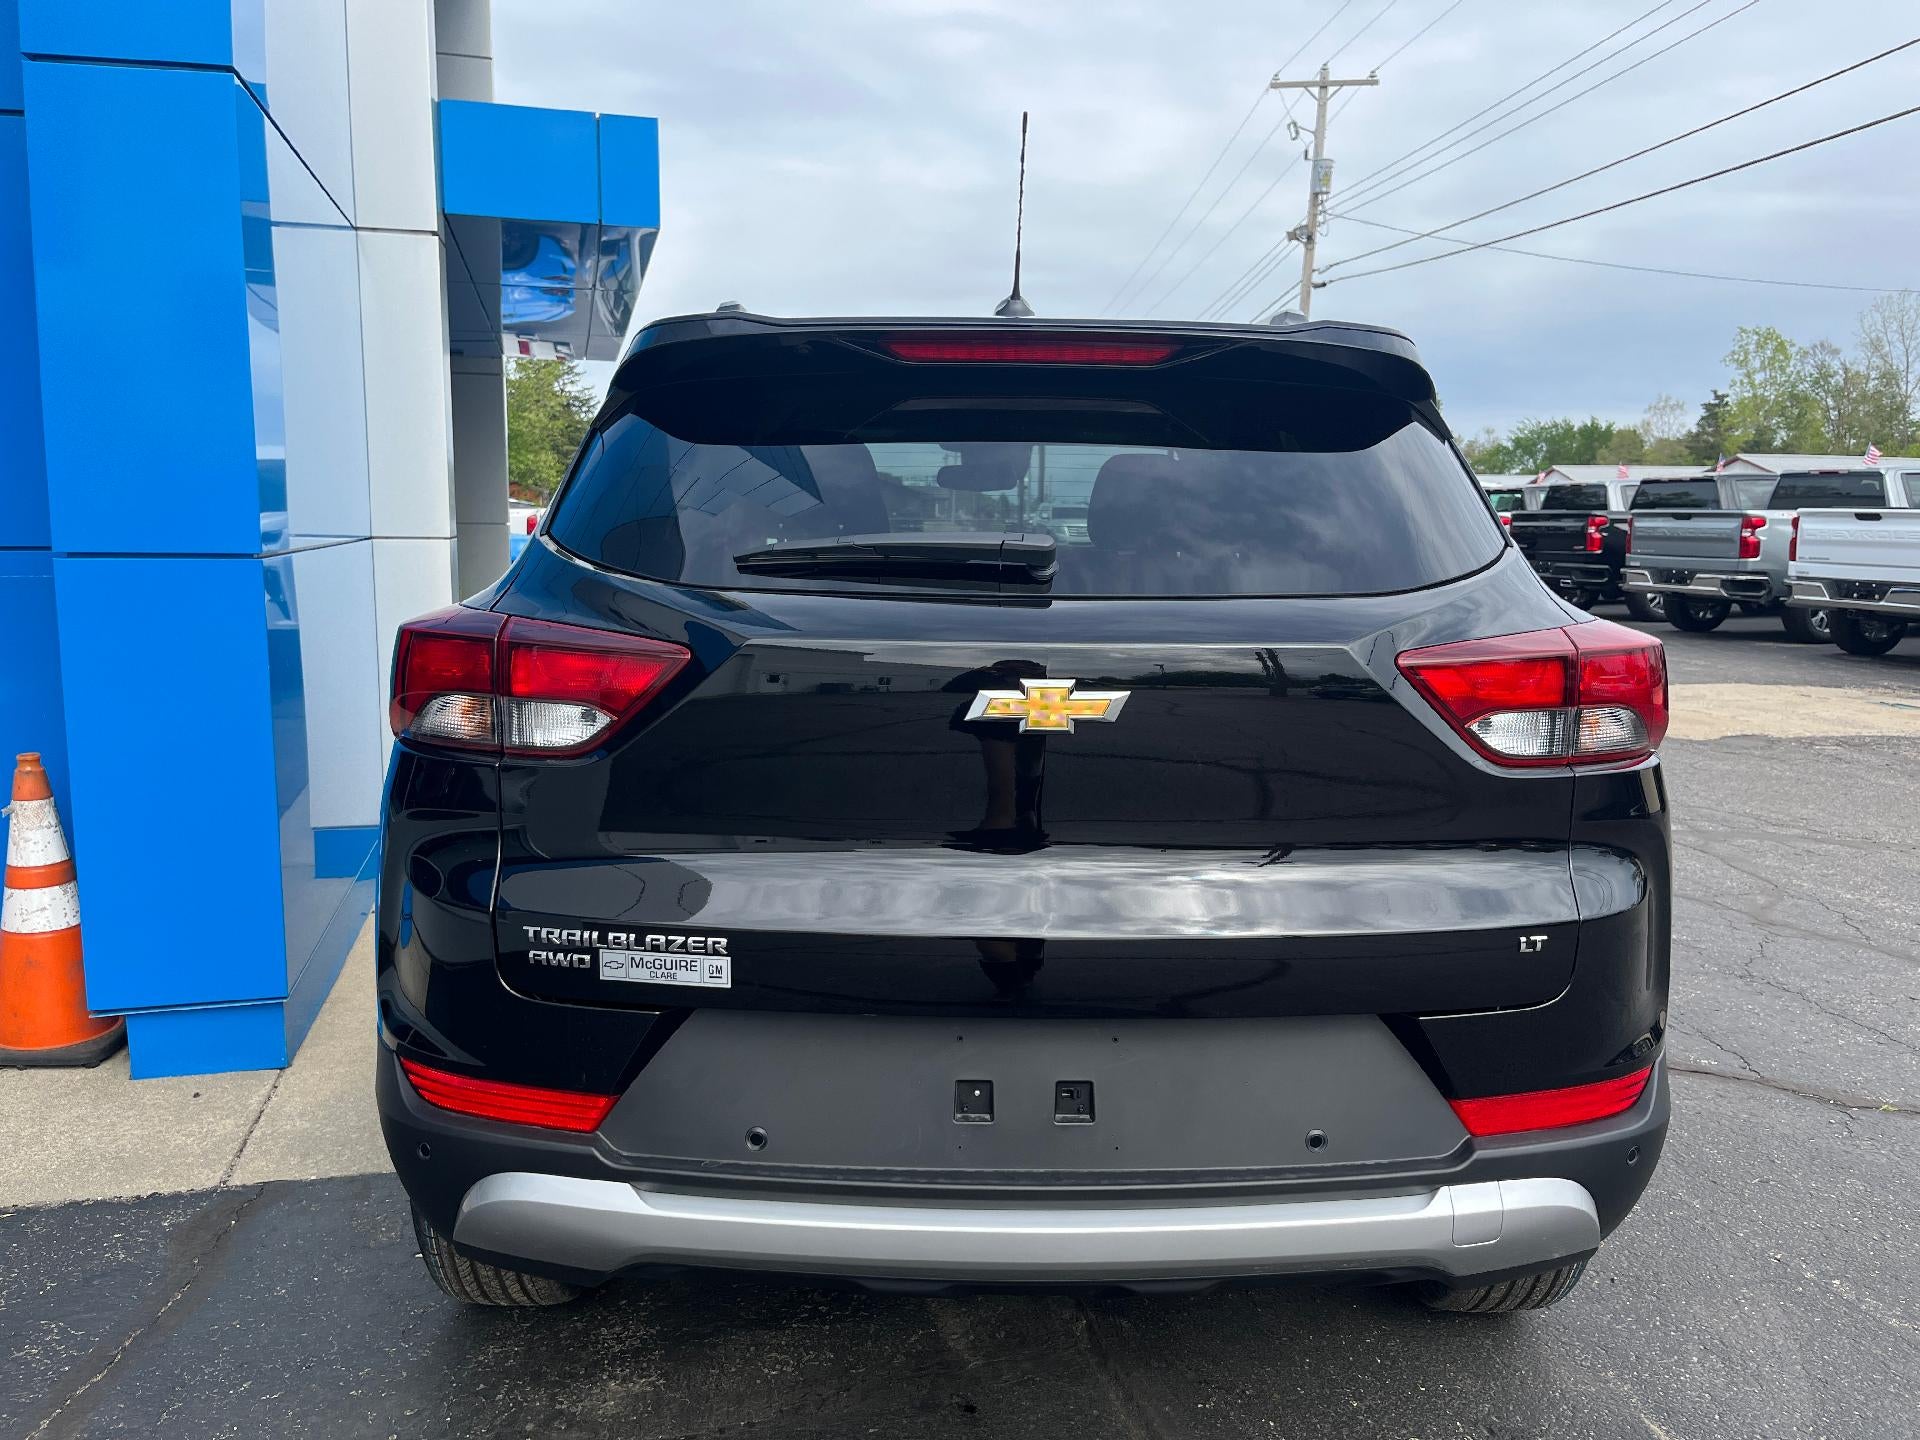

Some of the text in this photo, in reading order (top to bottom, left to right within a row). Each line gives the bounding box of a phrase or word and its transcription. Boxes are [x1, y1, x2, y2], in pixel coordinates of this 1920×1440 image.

[523, 926, 728, 954] TRAILBLAZER
[1520, 936, 1548, 952] LT
[529, 950, 591, 968] AWD
[630, 957, 698, 972] McGUIRE
[649, 970, 678, 980] CLARE
[708, 964, 722, 975] GM
